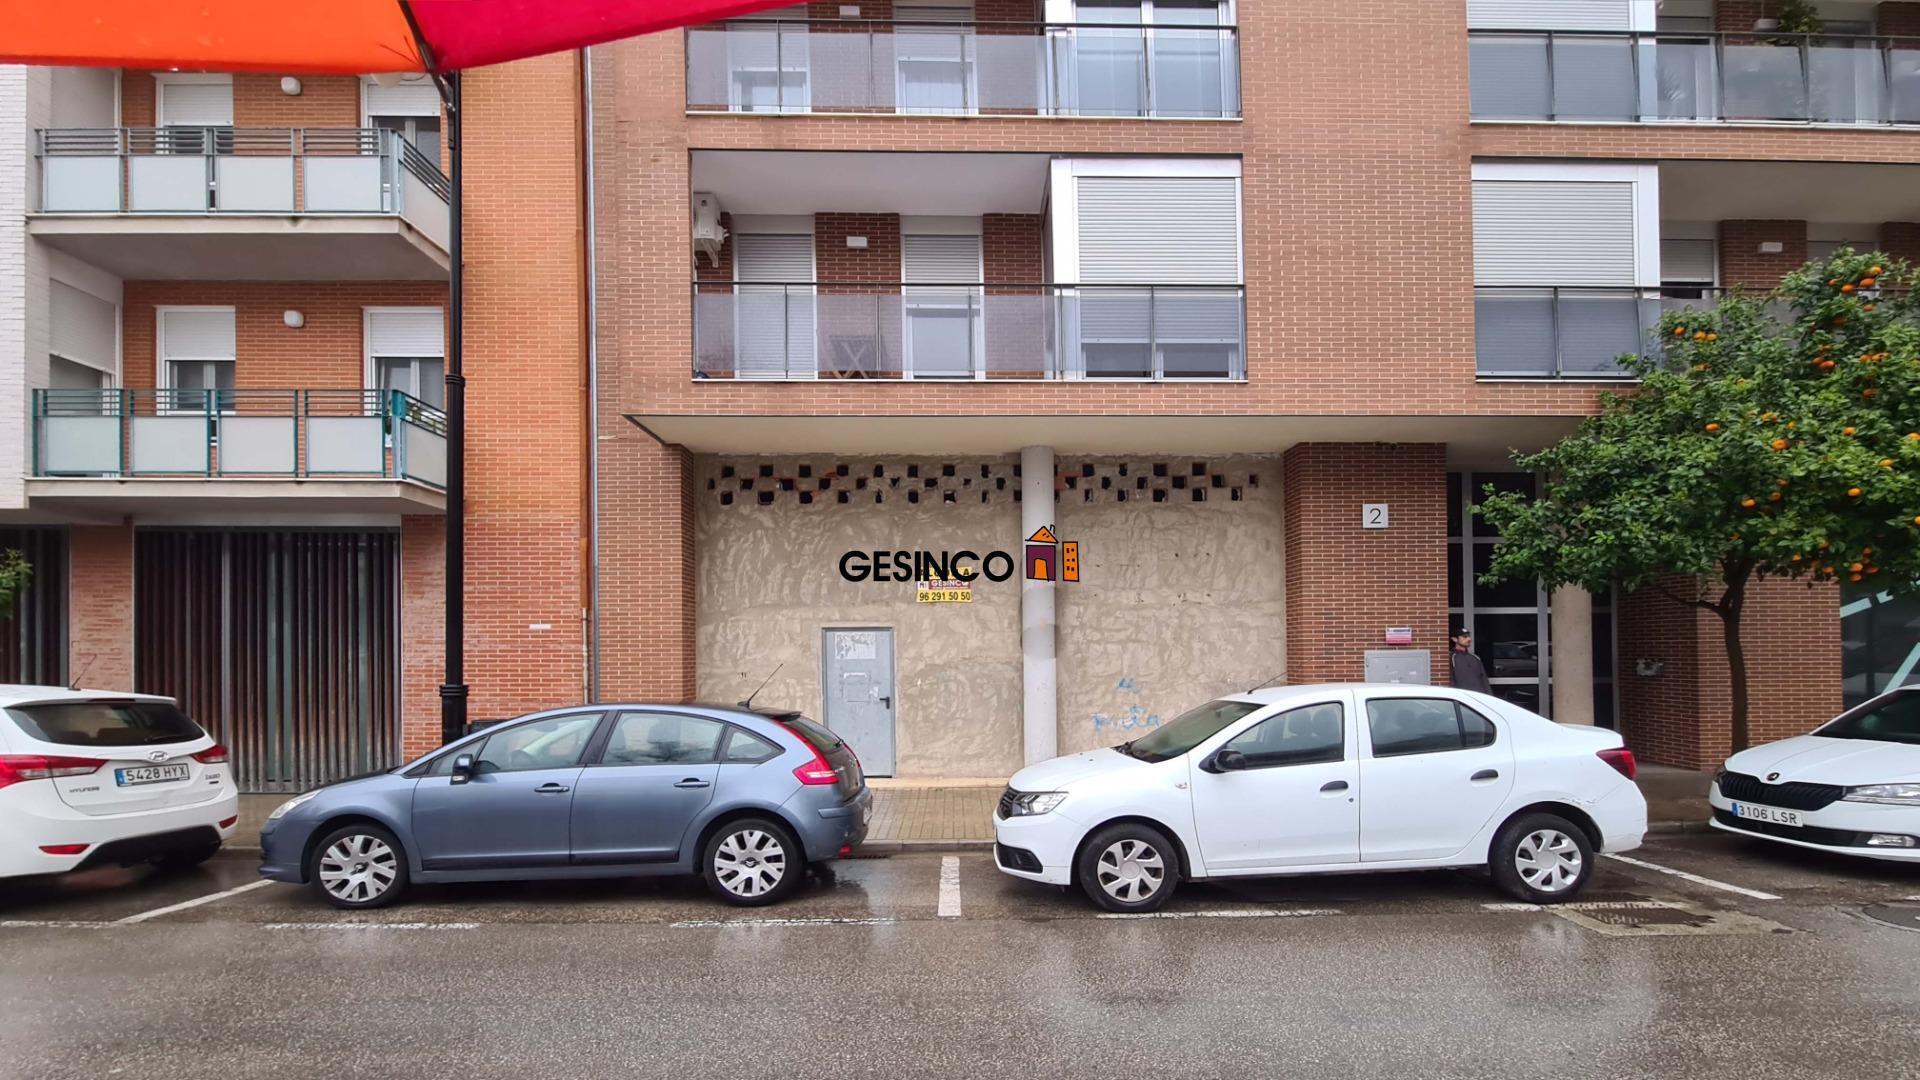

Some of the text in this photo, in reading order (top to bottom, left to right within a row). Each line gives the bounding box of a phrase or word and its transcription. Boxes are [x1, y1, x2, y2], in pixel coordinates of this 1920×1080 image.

[1369, 507, 1382, 524] 2
[919, 591, 971, 601] 96 291 50 50
[126, 766, 186, 781] 5428 HYX
[1738, 805, 1798, 824] 3106 LSR
